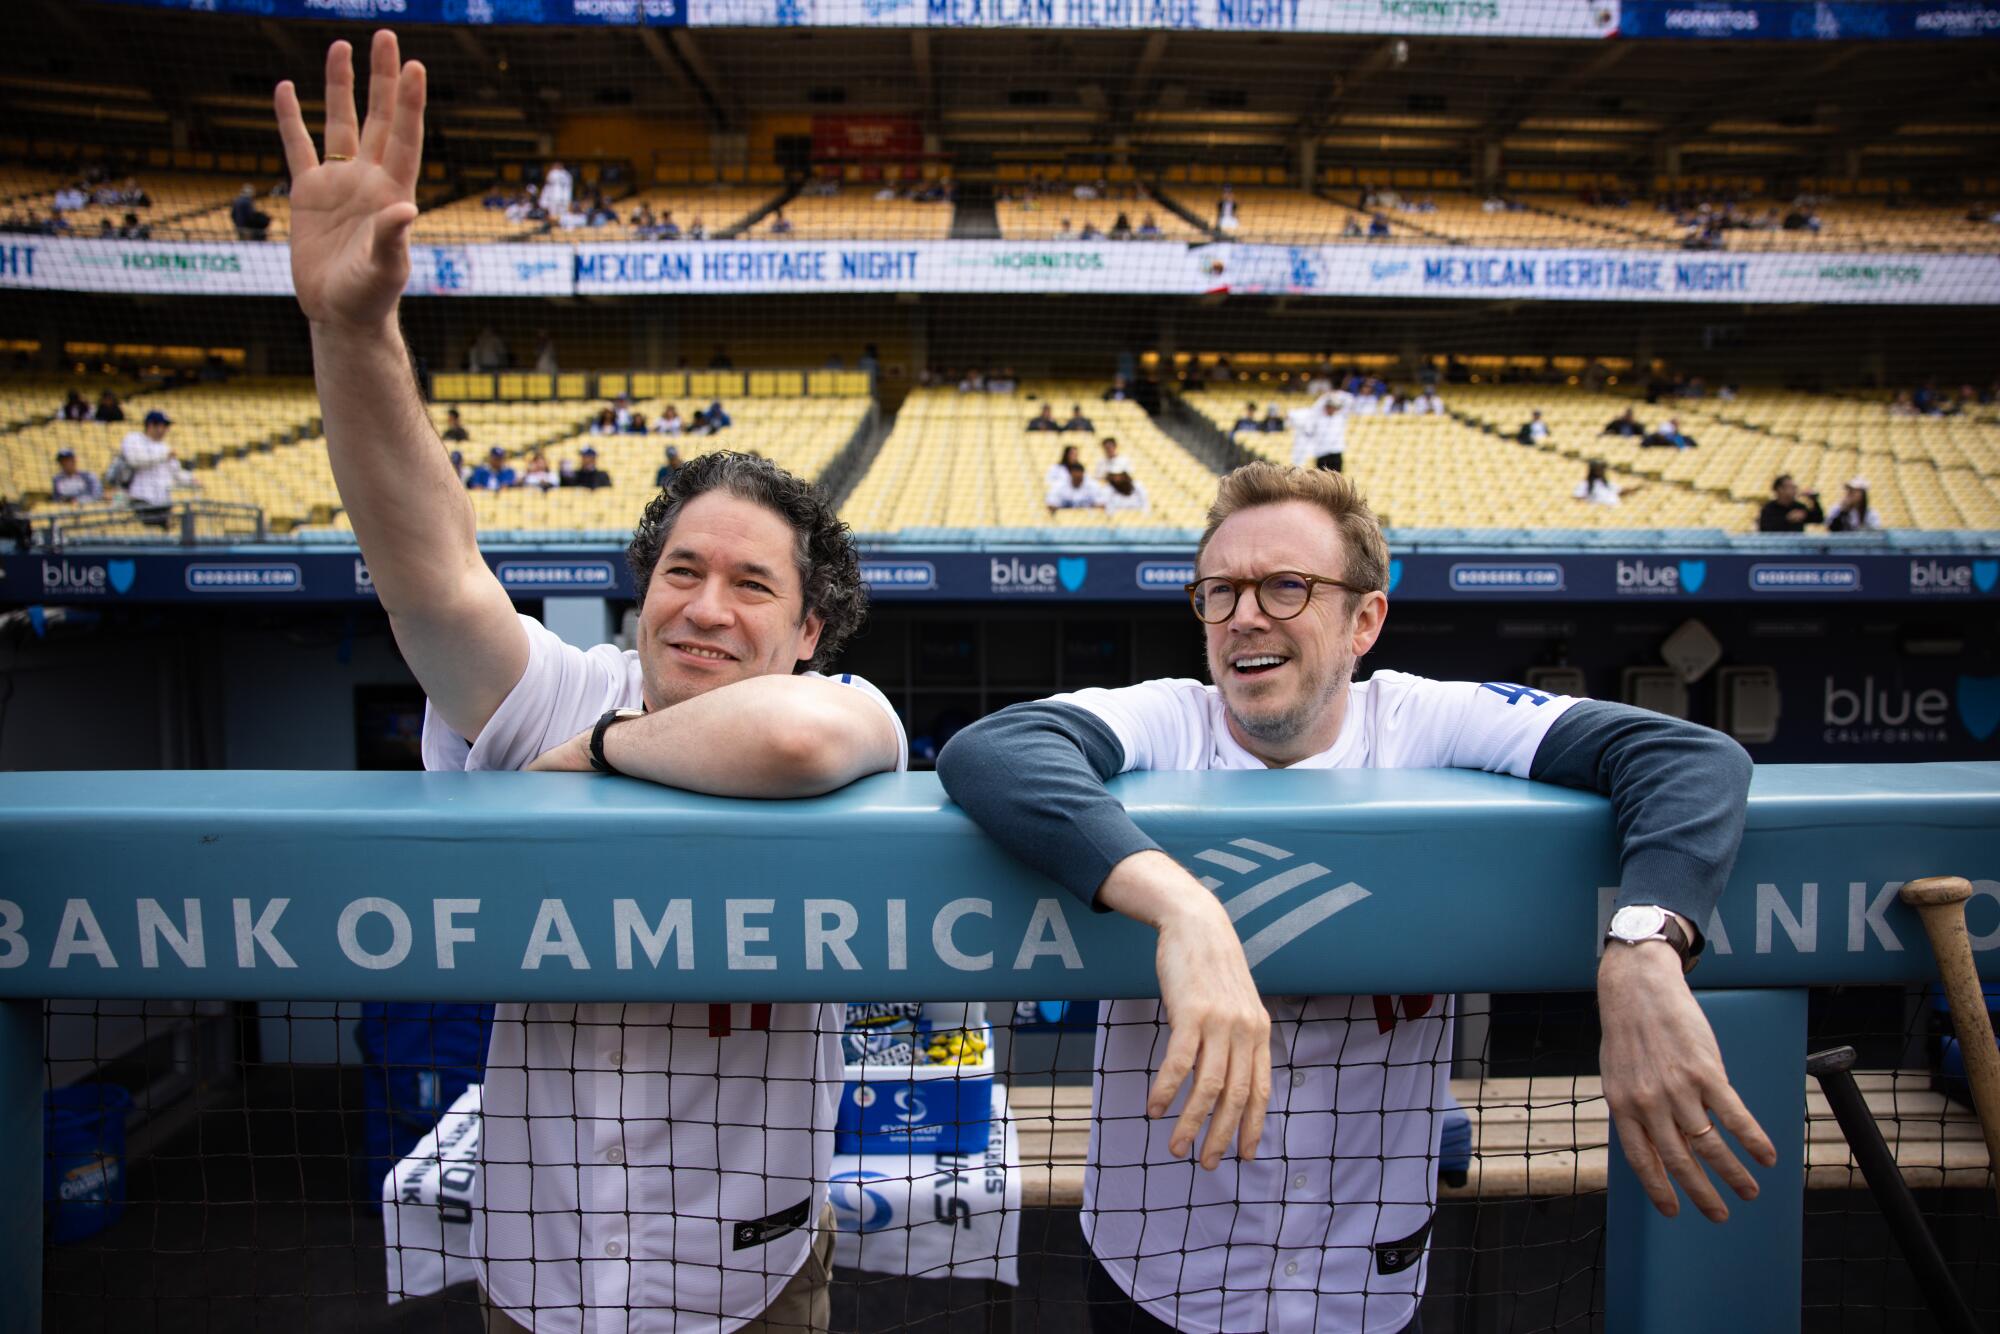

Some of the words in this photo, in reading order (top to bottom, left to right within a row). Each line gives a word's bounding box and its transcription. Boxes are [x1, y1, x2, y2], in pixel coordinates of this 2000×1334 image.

[928, 0, 1053, 26] MEXICAN
[1067, 0, 1203, 28] HERITAGE
[1217, 0, 1298, 29] NIGHT
[575, 252, 691, 281] MEXICAN
[703, 252, 827, 281] HERITAGE
[840, 252, 918, 280] NIGHT
[1424, 257, 1535, 285] MEXICAN
[1545, 259, 1664, 289] HERITAGE
[1674, 262, 1749, 291] NIGHT
[42, 558, 106, 587] blue
[991, 557, 1057, 585] blue
[1616, 560, 1679, 587] blue
[1910, 560, 1972, 587] blue
[1824, 675, 1949, 726] blue
[1824, 728, 1948, 744] CALIFORNIA
[0, 898, 299, 969] BANK
[337, 896, 481, 970] OF
[520, 897, 1085, 972] AMERICA
[1596, 881, 1905, 958] NK
